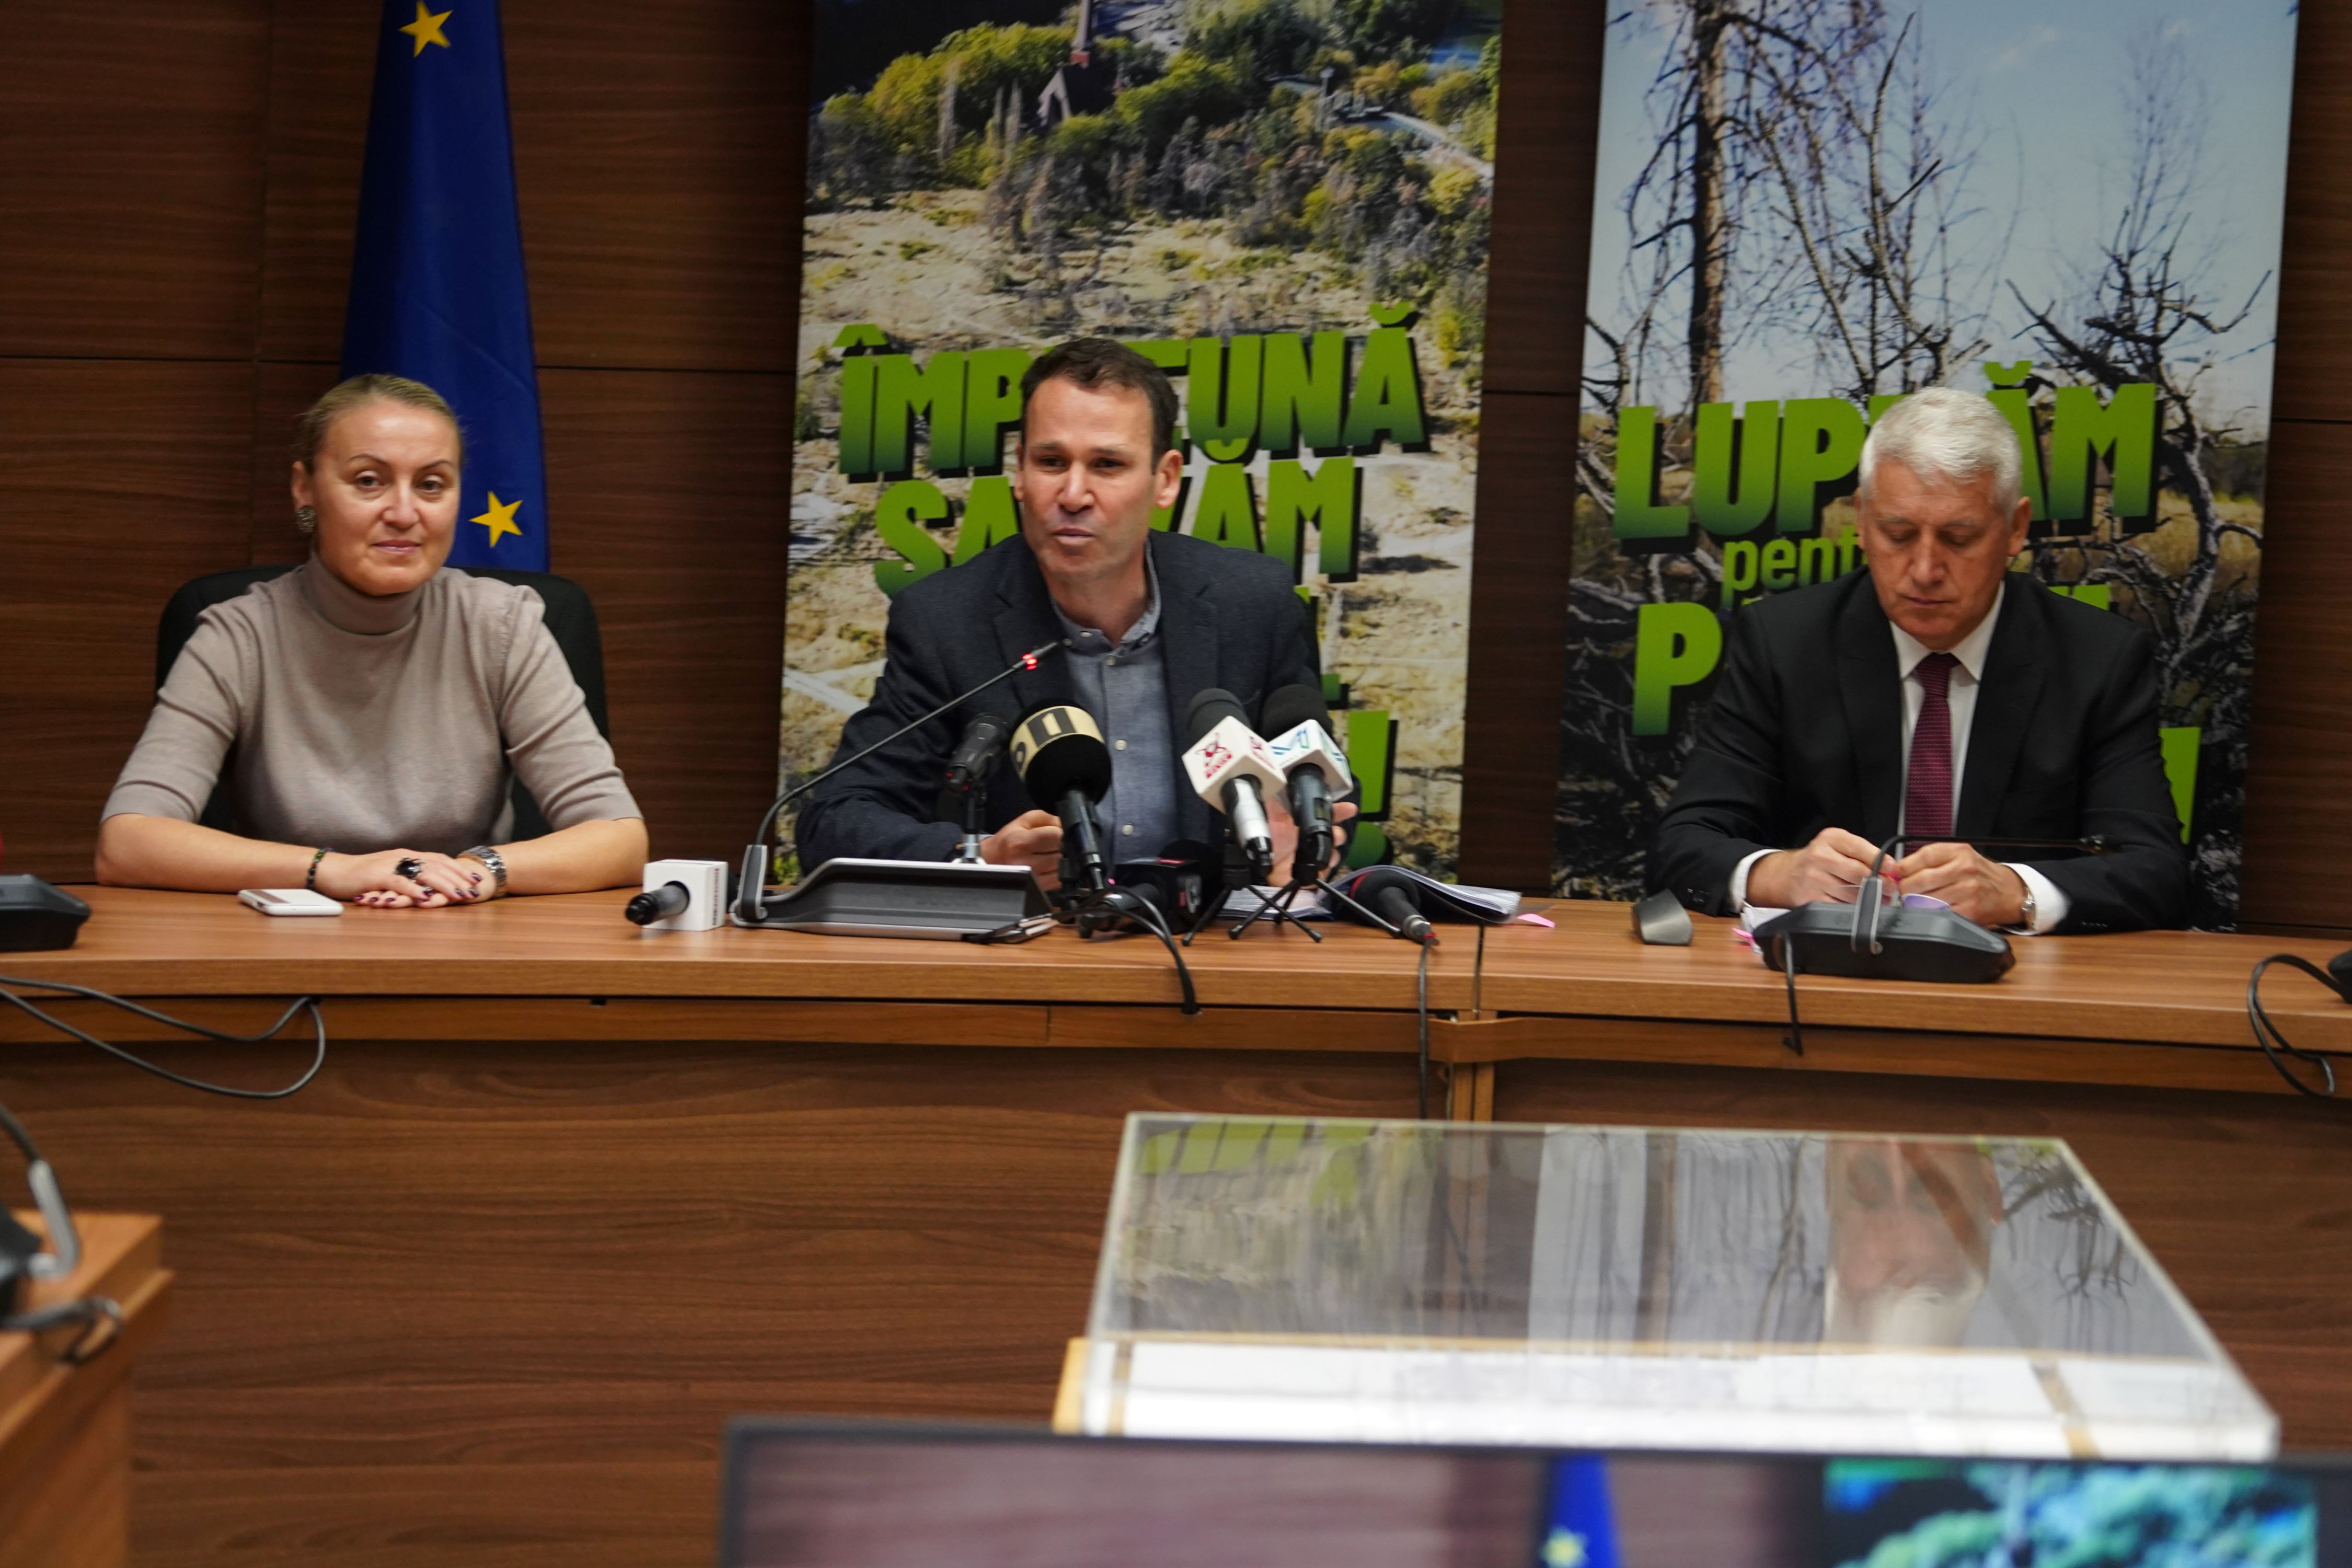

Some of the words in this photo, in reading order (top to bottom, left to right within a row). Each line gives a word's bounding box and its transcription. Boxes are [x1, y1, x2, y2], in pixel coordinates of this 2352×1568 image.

[834, 302, 1425, 475] ÎMPUNĂ
[1613, 360, 2155, 539] LUPĂM
[874, 438, 1354, 597] SAĂM
[1720, 524, 1868, 610] pent
